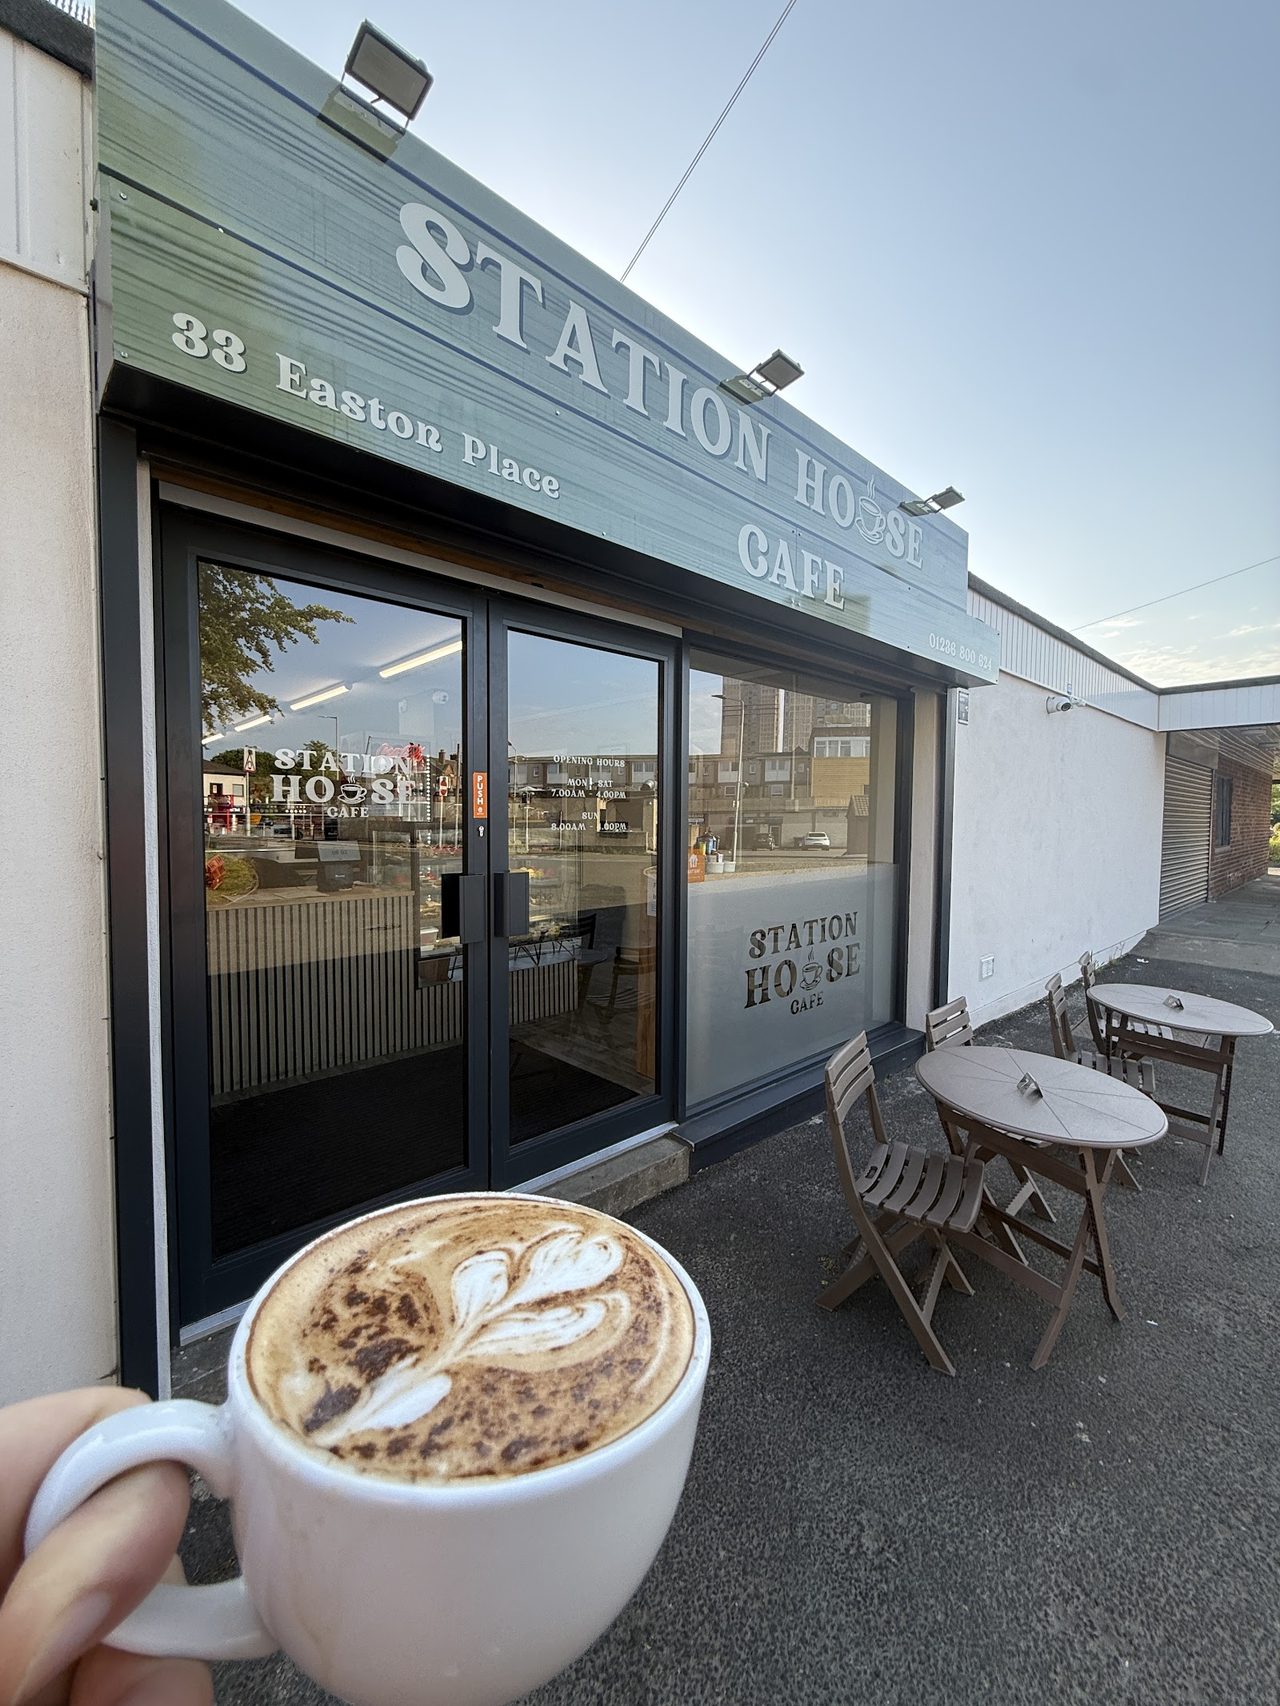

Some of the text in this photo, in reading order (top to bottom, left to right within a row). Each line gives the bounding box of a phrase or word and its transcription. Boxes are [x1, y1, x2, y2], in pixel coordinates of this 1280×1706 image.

[396, 202, 773, 484] STATION
[171, 312, 561, 500] 33 Easton Place
[737, 523, 846, 612] CAFE
[959, 645, 976, 664] 800
[978, 654, 993, 671] 624
[274, 748, 414, 778] STATION
[553, 754, 625, 767] OPENING HOURS
[476, 775, 484, 805] PUSH
[551, 788, 586, 798] 7.00AM
[595, 790, 627, 799] 4.00PM
[566, 778, 613, 788] MON SAT
[326, 806, 369, 818] CAFE
[551, 822, 587, 831] 8.00AM
[749, 911, 858, 959] STATION
[790, 990, 824, 1015] CAFE
